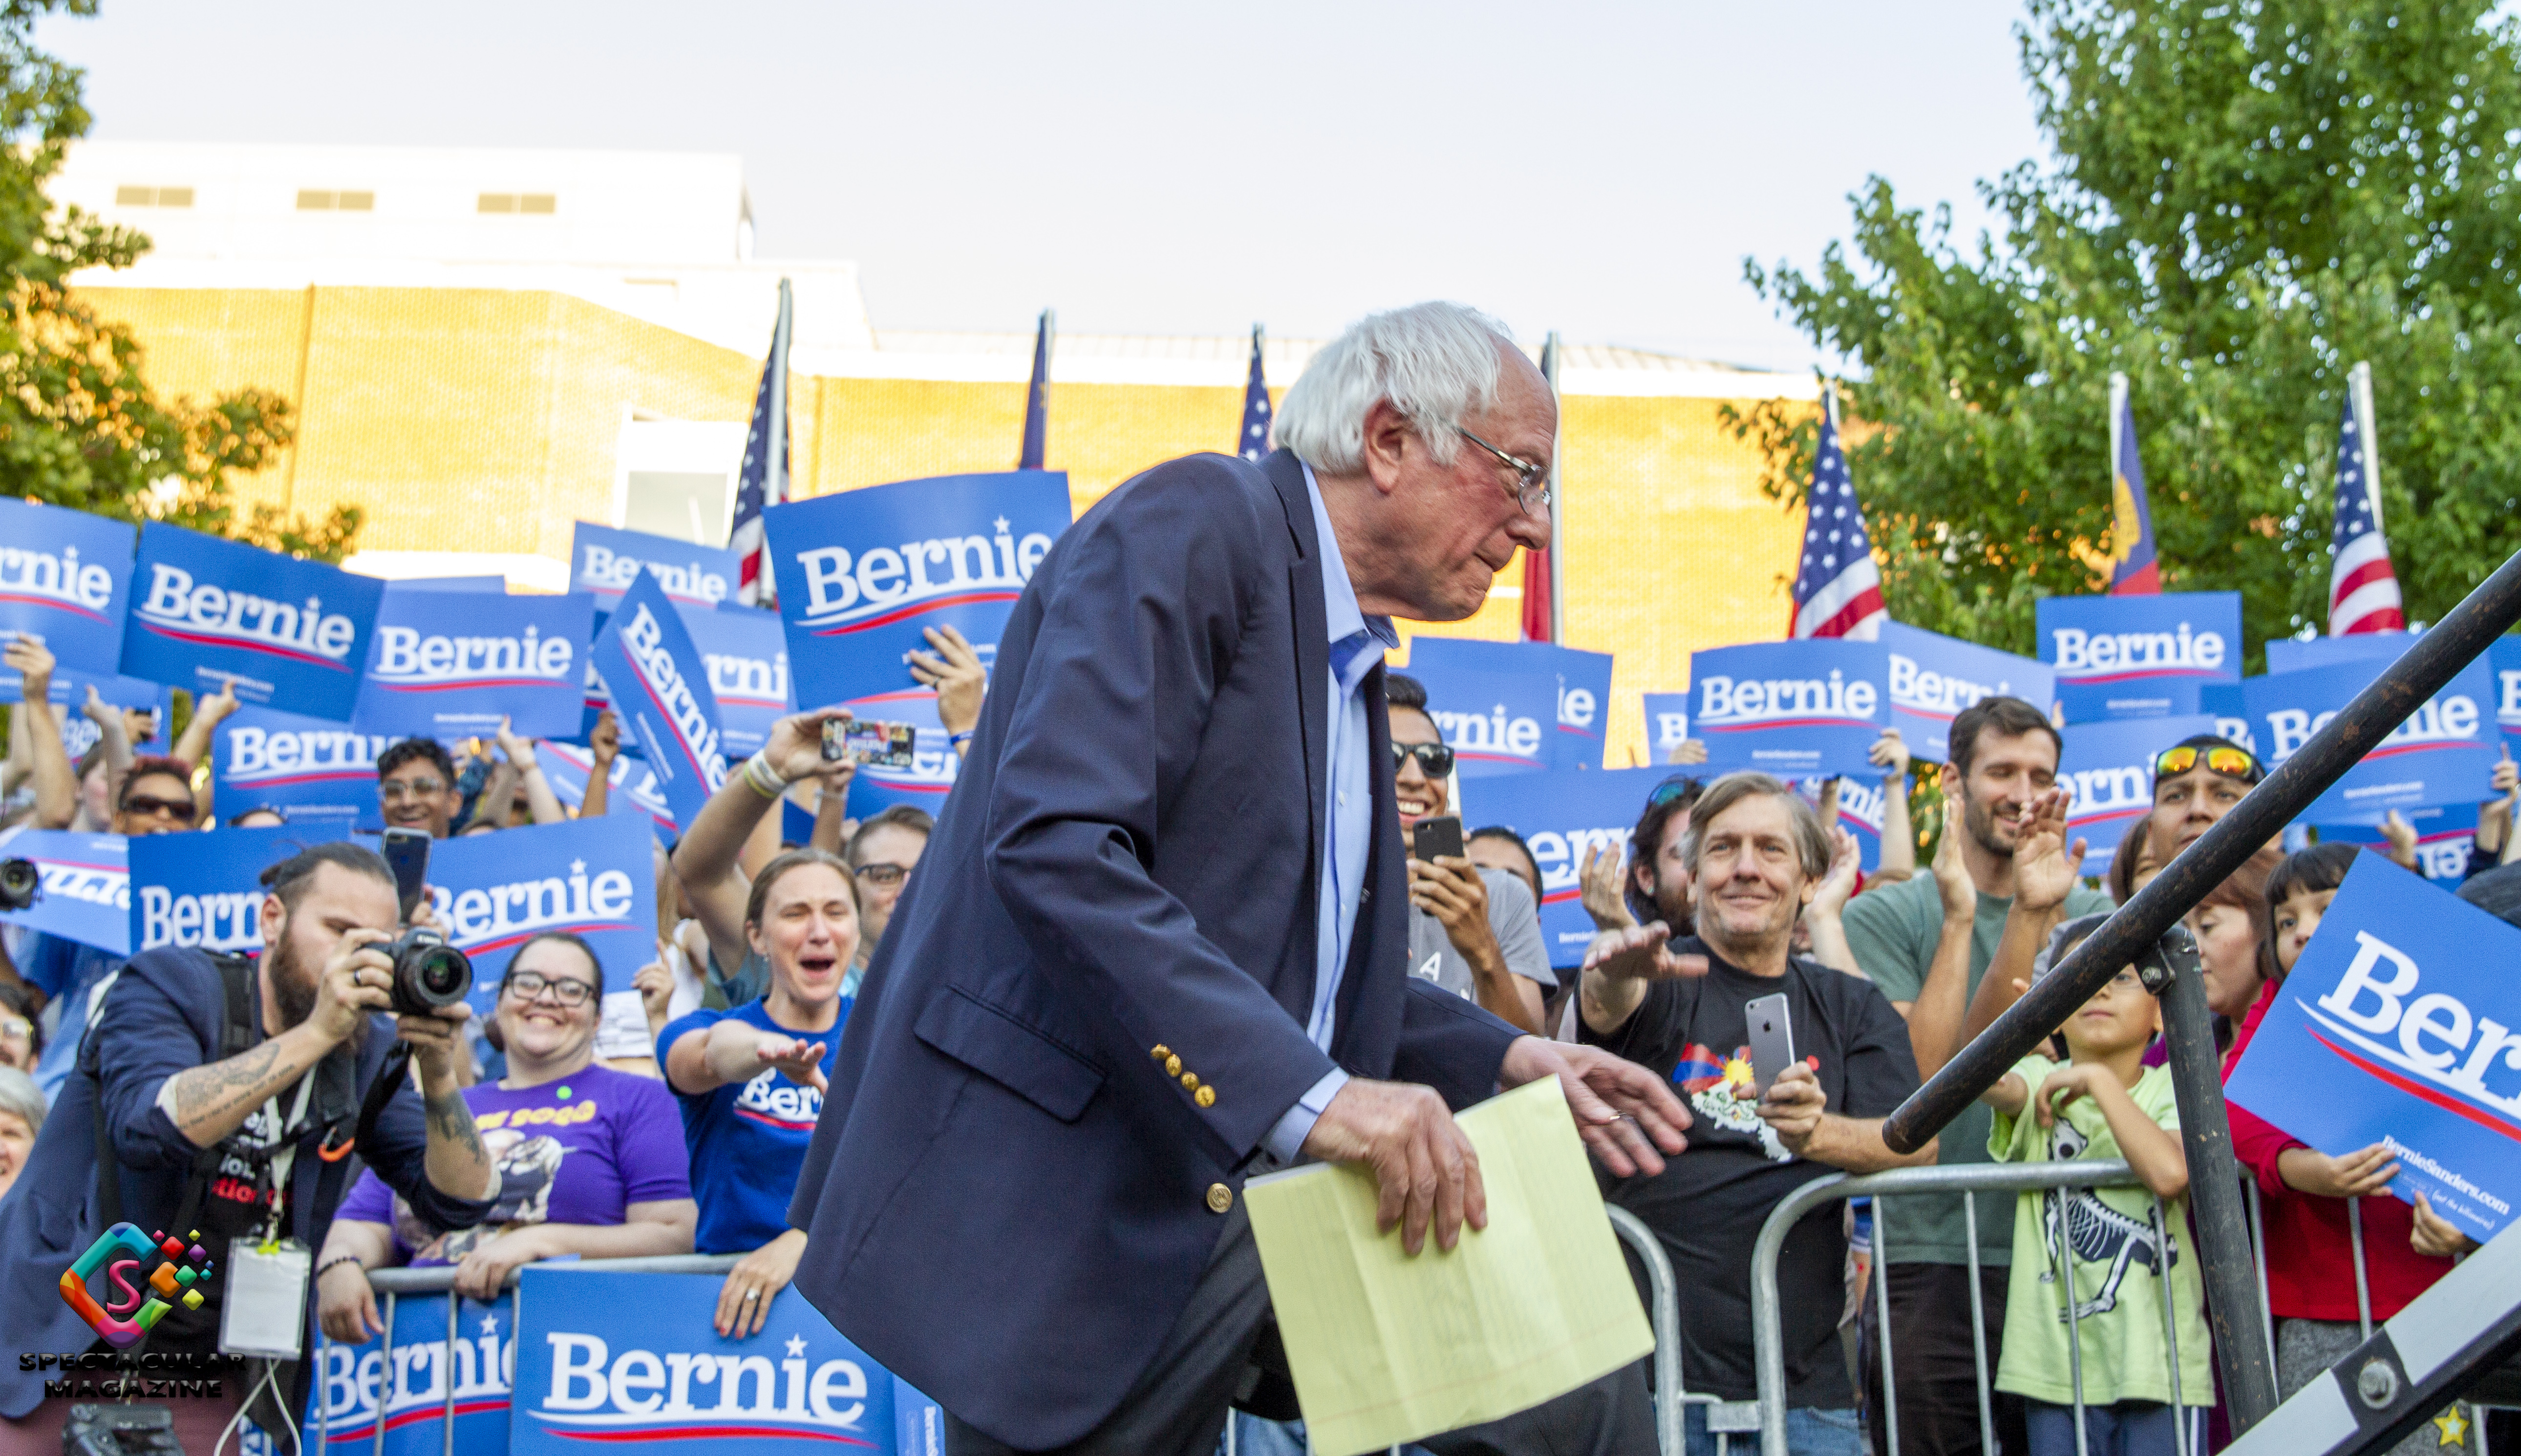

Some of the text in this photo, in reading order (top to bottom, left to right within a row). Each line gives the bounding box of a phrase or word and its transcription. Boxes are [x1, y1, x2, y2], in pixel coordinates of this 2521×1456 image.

[0, 546, 113, 610] rnie
[796, 514, 1054, 617] Bernie
[141, 563, 356, 658] Bernie
[375, 624, 573, 677] Bernie
[704, 652, 788, 701] rni
[2053, 621, 2225, 669] Bernie
[623, 601, 727, 792] Bernie
[1698, 668, 1877, 719] Bernie
[1430, 703, 1540, 757] rnie
[140, 885, 266, 950] Bern
[2317, 930, 2521, 1102] Ber
[736, 1071, 824, 1121] Ber
[542, 1331, 868, 1423] Bernie
